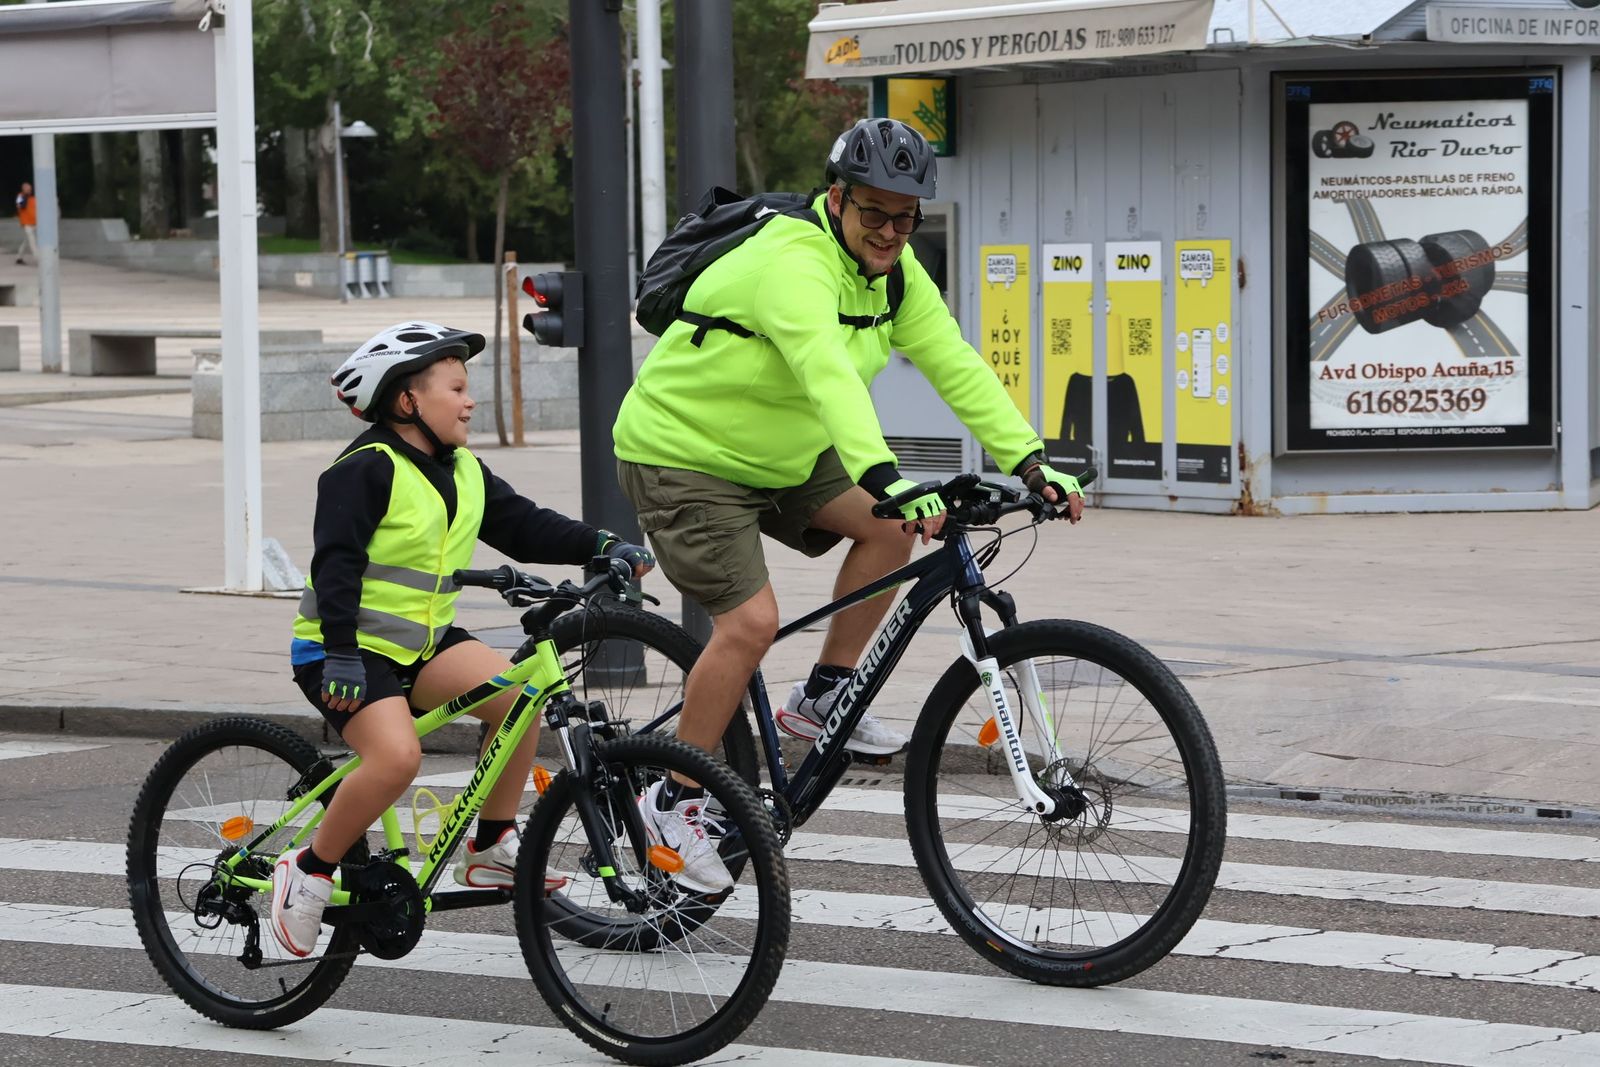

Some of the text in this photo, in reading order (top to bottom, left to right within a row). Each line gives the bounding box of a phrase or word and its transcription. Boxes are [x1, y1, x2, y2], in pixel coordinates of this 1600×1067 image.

[1450, 17, 1513, 35] OFICINA
[1518, 18, 1538, 36] DE
[827, 34, 859, 64] LADIS
[894, 37, 966, 65] TOLDOS
[971, 36, 983, 59] Y
[987, 27, 1087, 58] PERGOLAS
[1095, 30, 1114, 49] TEL:
[1117, 27, 1136, 47] 980
[1158, 23, 1176, 44] 127
[1369, 111, 1516, 131] Neumaticos
[1390, 139, 1522, 158] Rio Duero
[1320, 172, 1515, 187] NEUMÁTICOS-PASTILLAS DE FRENO
[1313, 185, 1523, 200] AMORTIGUADORES-MECÁNICA RÁPIDA
[988, 258, 1015, 267] ZAMORA
[1053, 255, 1083, 274] ZINQ
[1117, 254, 1151, 273] ZINQ
[1181, 253, 1211, 263] ZAMORA
[1181, 263, 1211, 272] INQUIETA
[1318, 275, 1424, 324] FURGONETAS
[1431, 242, 1513, 281] TURISMOS
[1372, 292, 1430, 325] MOTOS
[991, 329, 1021, 344] HOY
[354, 350, 402, 362] ROCKRIDER
[991, 347, 1021, 368] QUÉ
[996, 372, 1020, 387] AY
[1319, 360, 1515, 383] Avd Obispo Acuña,15
[1346, 387, 1487, 415] 616825369
[814, 598, 913, 756] ROCKRIDER
[992, 689, 1027, 773] manitou
[428, 734, 502, 864] ROCKRIDER
[1015, 952, 1085, 973] HUTCHINSON
